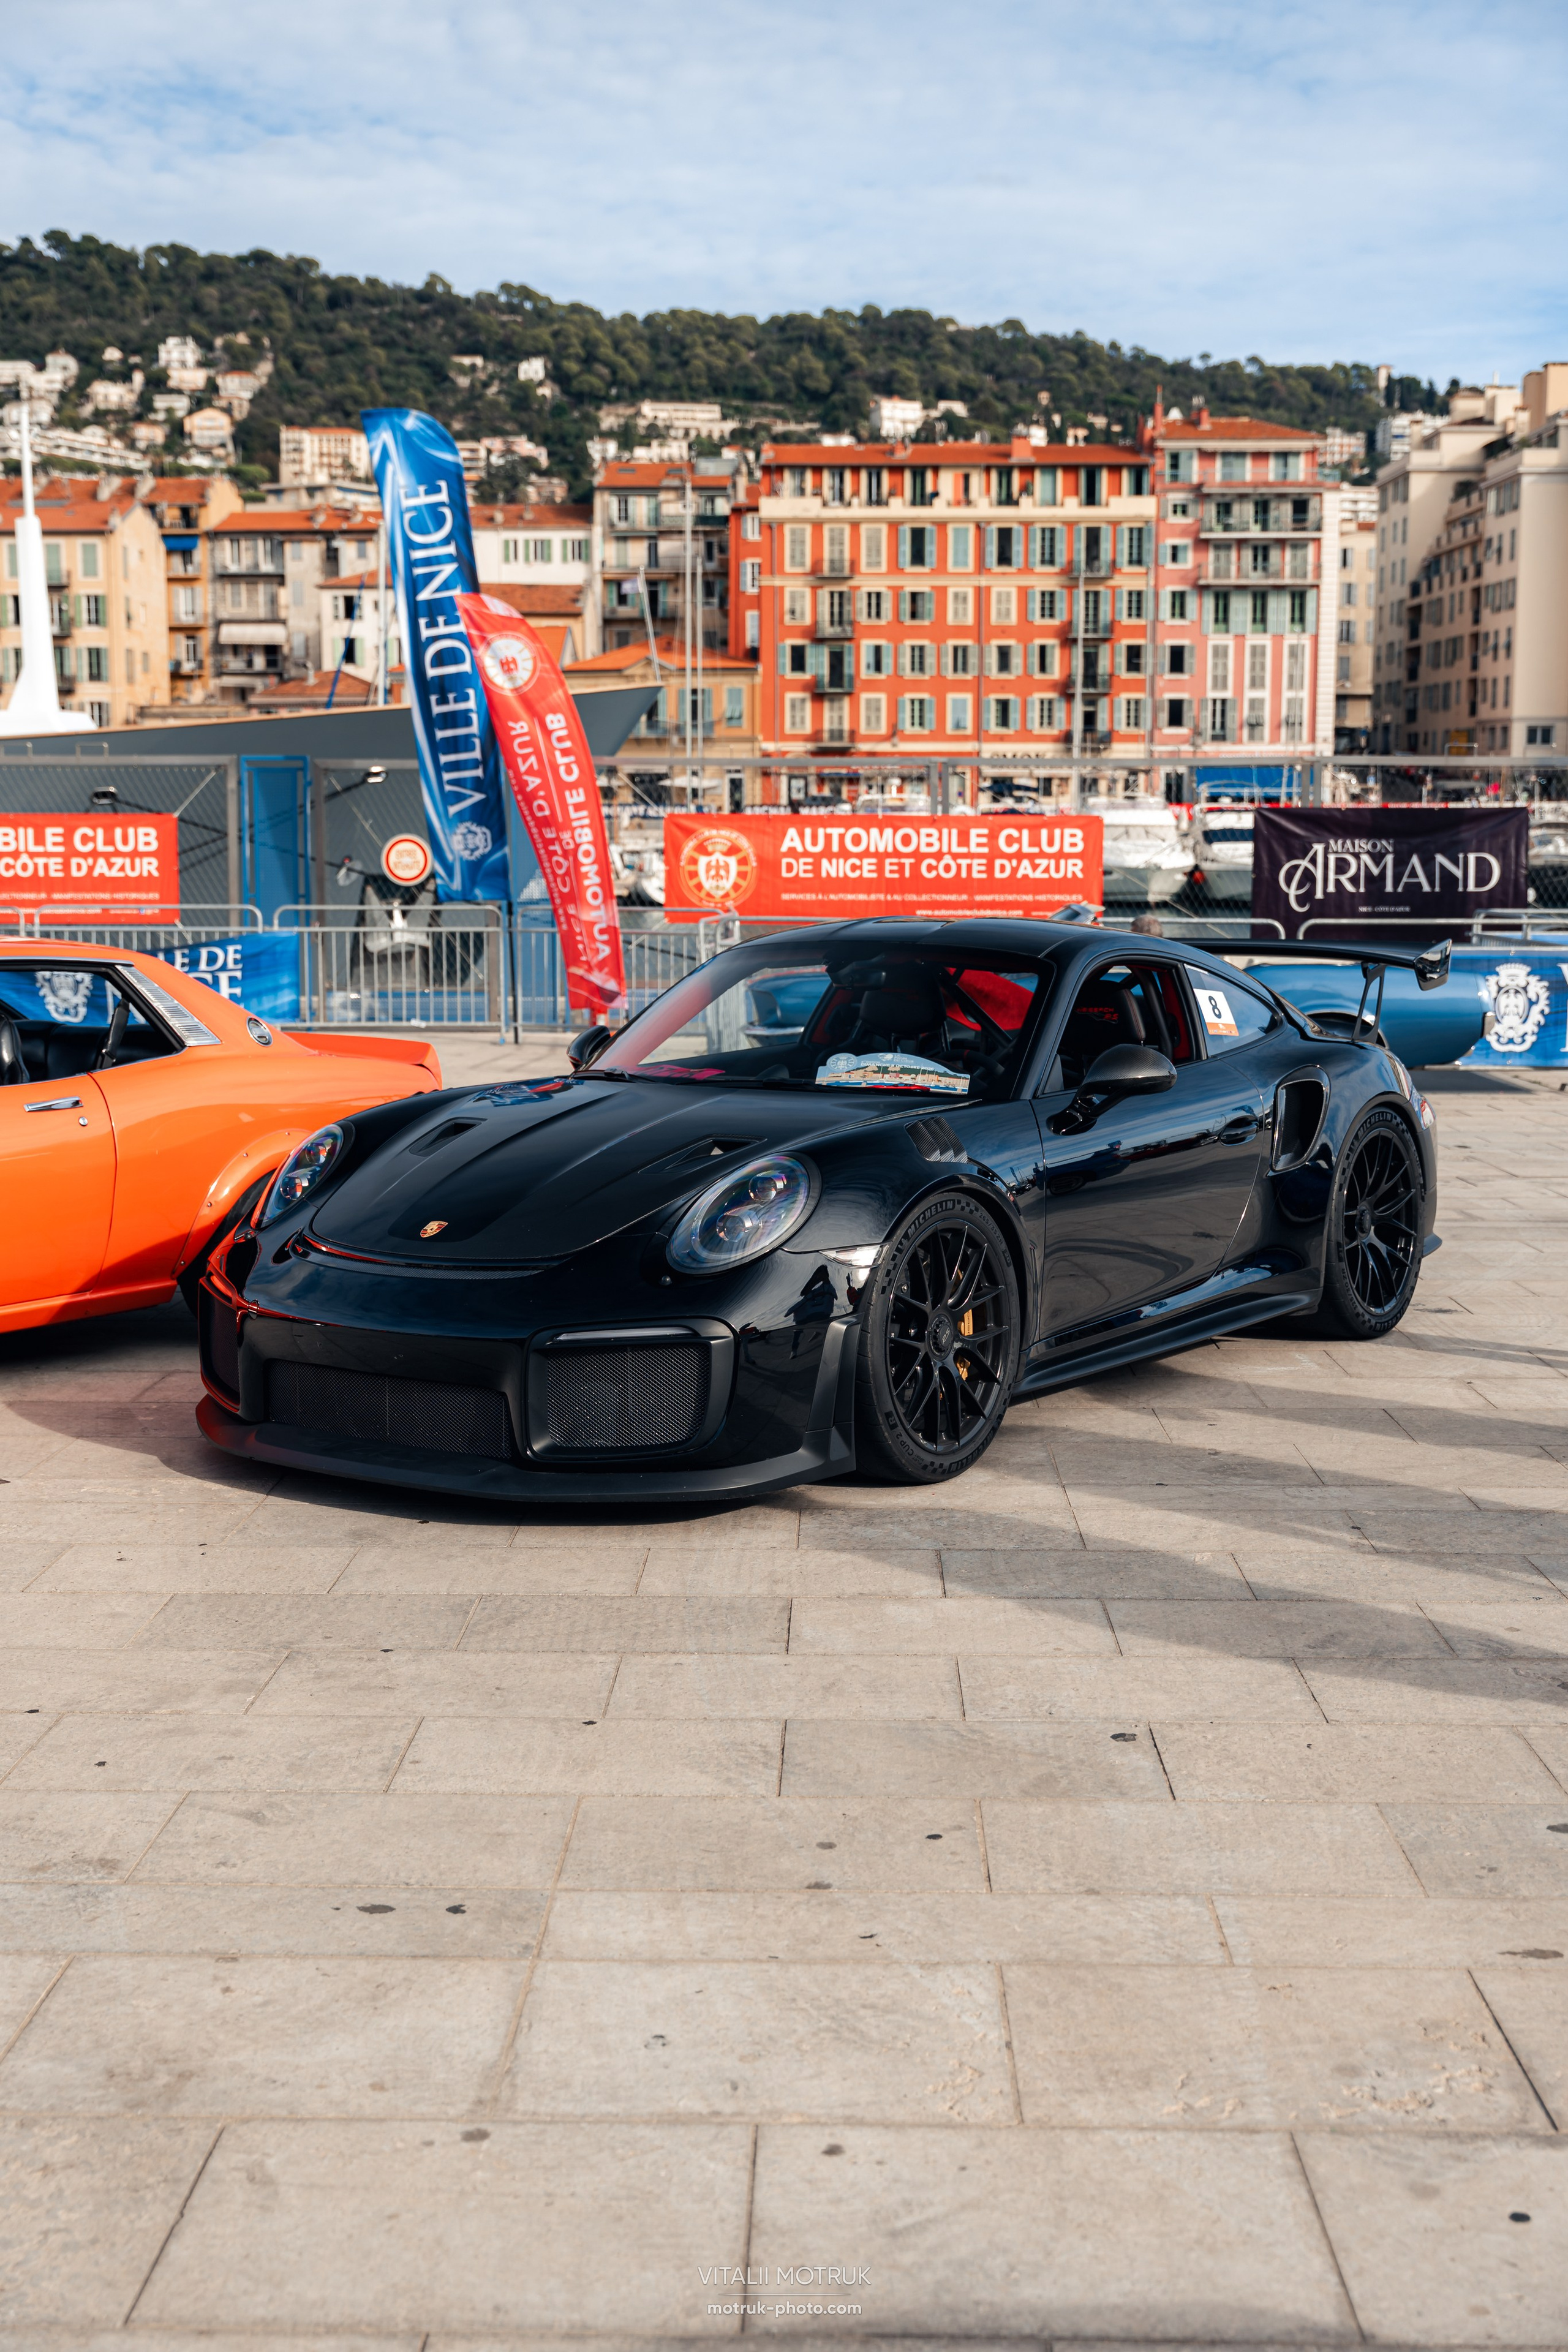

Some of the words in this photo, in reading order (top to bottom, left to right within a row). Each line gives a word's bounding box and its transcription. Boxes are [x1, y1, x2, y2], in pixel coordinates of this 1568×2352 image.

[400, 479, 462, 601] NICE
[418, 612, 472, 681] DE
[429, 687, 486, 818] VILLE
[73, 826, 159, 853] CLUB
[780, 827, 989, 854] AUTOMOBILE
[998, 827, 1085, 854] CLUB
[1328, 838, 1395, 853] MAISON
[0, 853, 65, 878] CÔTE
[70, 857, 160, 877] D'AZUR
[781, 858, 815, 878] DE
[821, 858, 878, 878] NICE
[884, 858, 916, 878] ET
[920, 854, 988, 879] CÔTE
[994, 858, 1084, 879] D'AZUR
[1278, 842, 1502, 913] ARMAND
[198, 944, 243, 971] DE
[1208, 995, 1222, 1019] 8
[1357, 1112, 1392, 1139] MICHELIN
[907, 1200, 954, 1238] MICHELIN
[900, 1441, 914, 1457] CUP
[950, 1430, 994, 1472] MICHELIN
